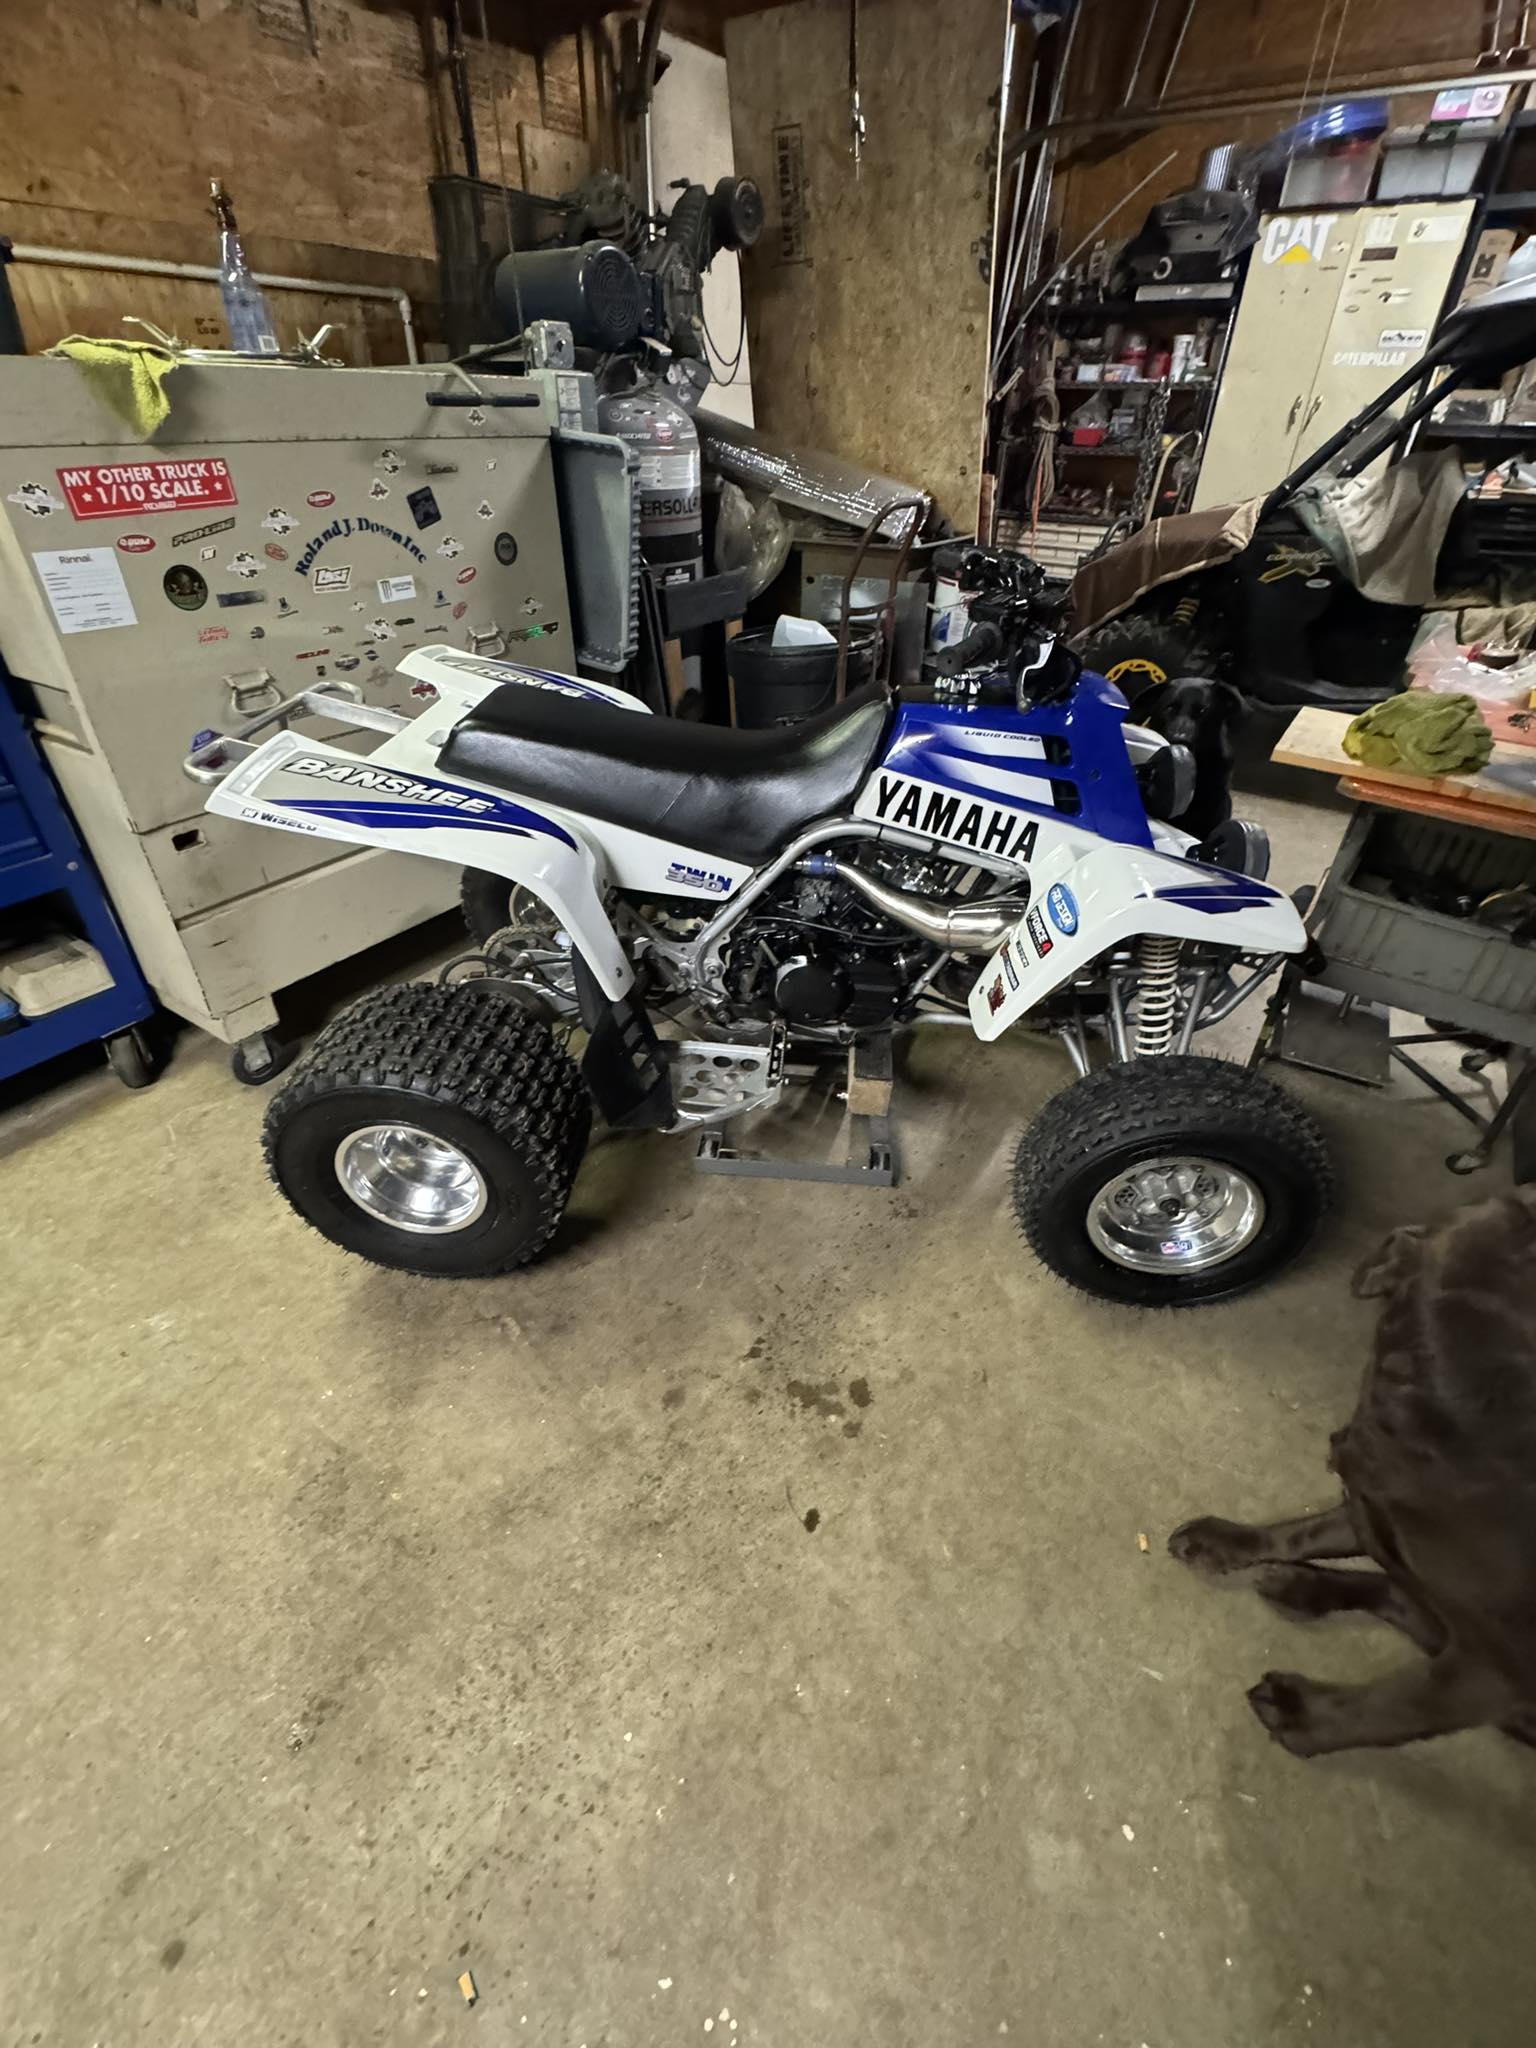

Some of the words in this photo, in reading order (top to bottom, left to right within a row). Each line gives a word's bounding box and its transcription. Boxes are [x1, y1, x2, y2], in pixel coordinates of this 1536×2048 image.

[1262, 215, 1339, 265] CAT
[1333, 351, 1408, 366] CATERPILLAR
[62, 469, 93, 488] MY
[97, 464, 154, 485] OTHER
[155, 462, 210, 481] TRUCK
[212, 461, 227, 477] IS
[96, 485, 146, 505] 1/10
[151, 480, 210, 500] SCALE.
[963, 729, 1002, 739] LIQUID
[1003, 733, 1041, 743] COOLED
[281, 757, 495, 815] BANSHEE
[876, 775, 1040, 863] YAMAHA
[665, 867, 724, 893] 350
[671, 862, 733, 892] TWIN
